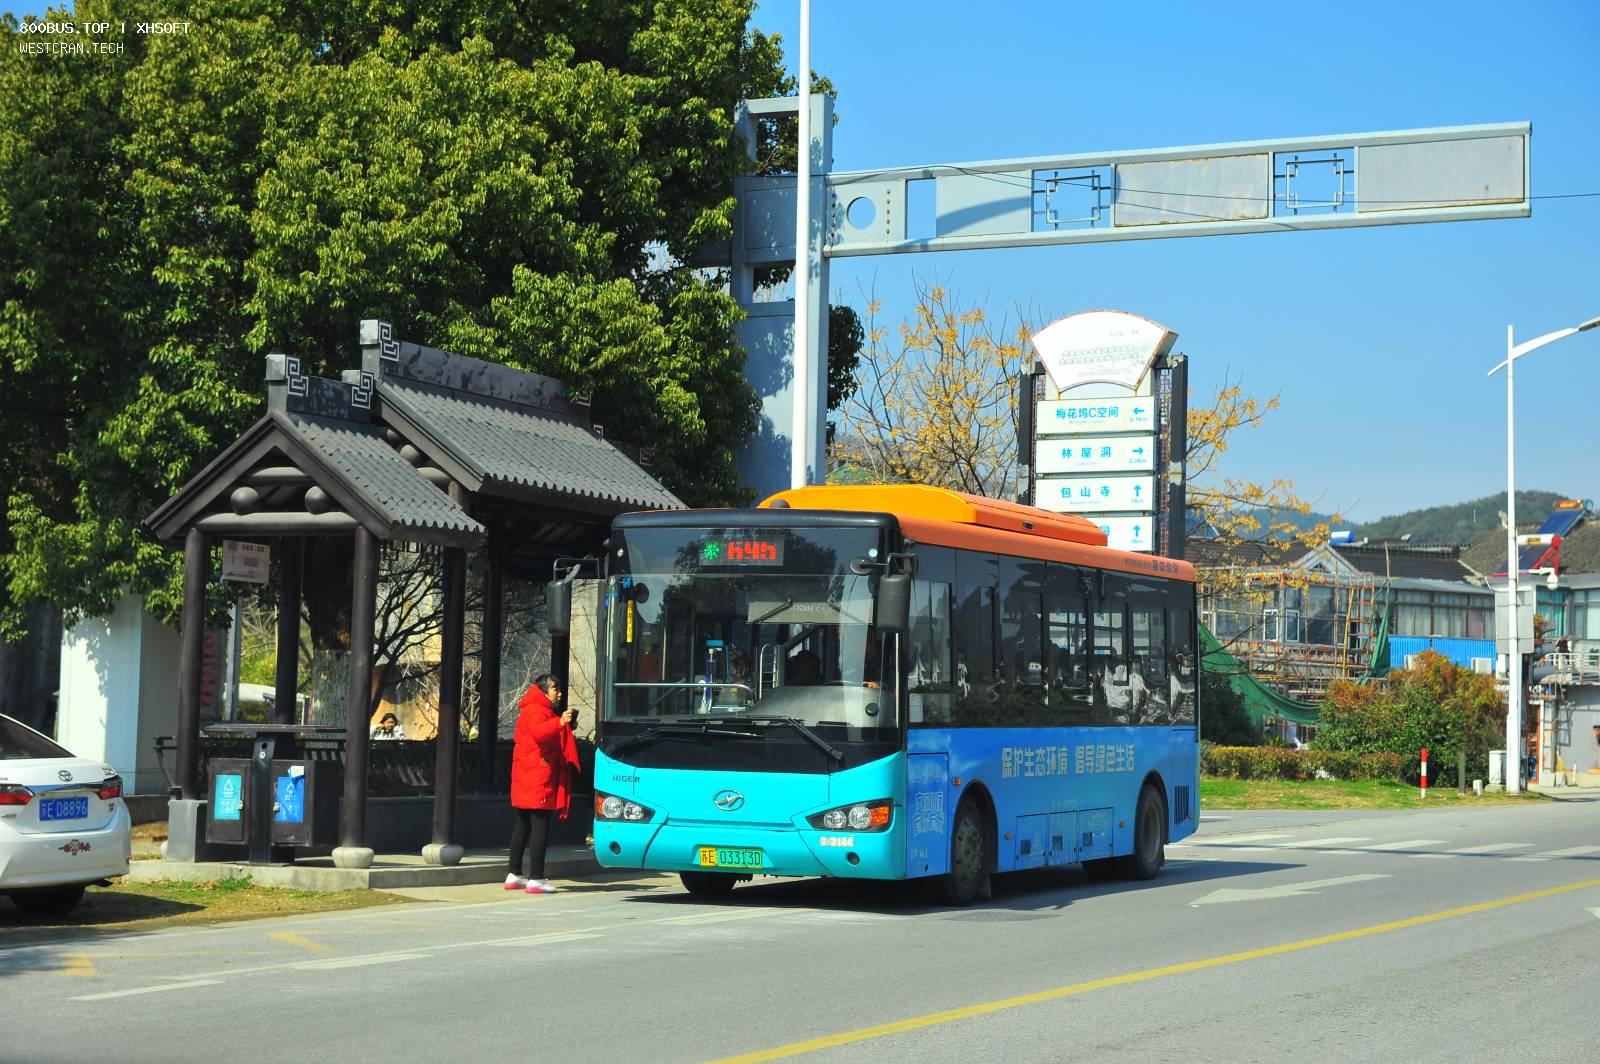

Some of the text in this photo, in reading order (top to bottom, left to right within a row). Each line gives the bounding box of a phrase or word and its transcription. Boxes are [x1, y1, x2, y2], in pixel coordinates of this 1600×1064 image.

[1056, 406, 1119, 420] 梅花坞C空间
[1062, 446, 1111, 459] 林屋洞
[1061, 485, 1111, 498] 包山寺
[1002, 743, 1136, 778] 保护生态环境 倡导绿色生活
[612, 774, 641, 784] HIGER
